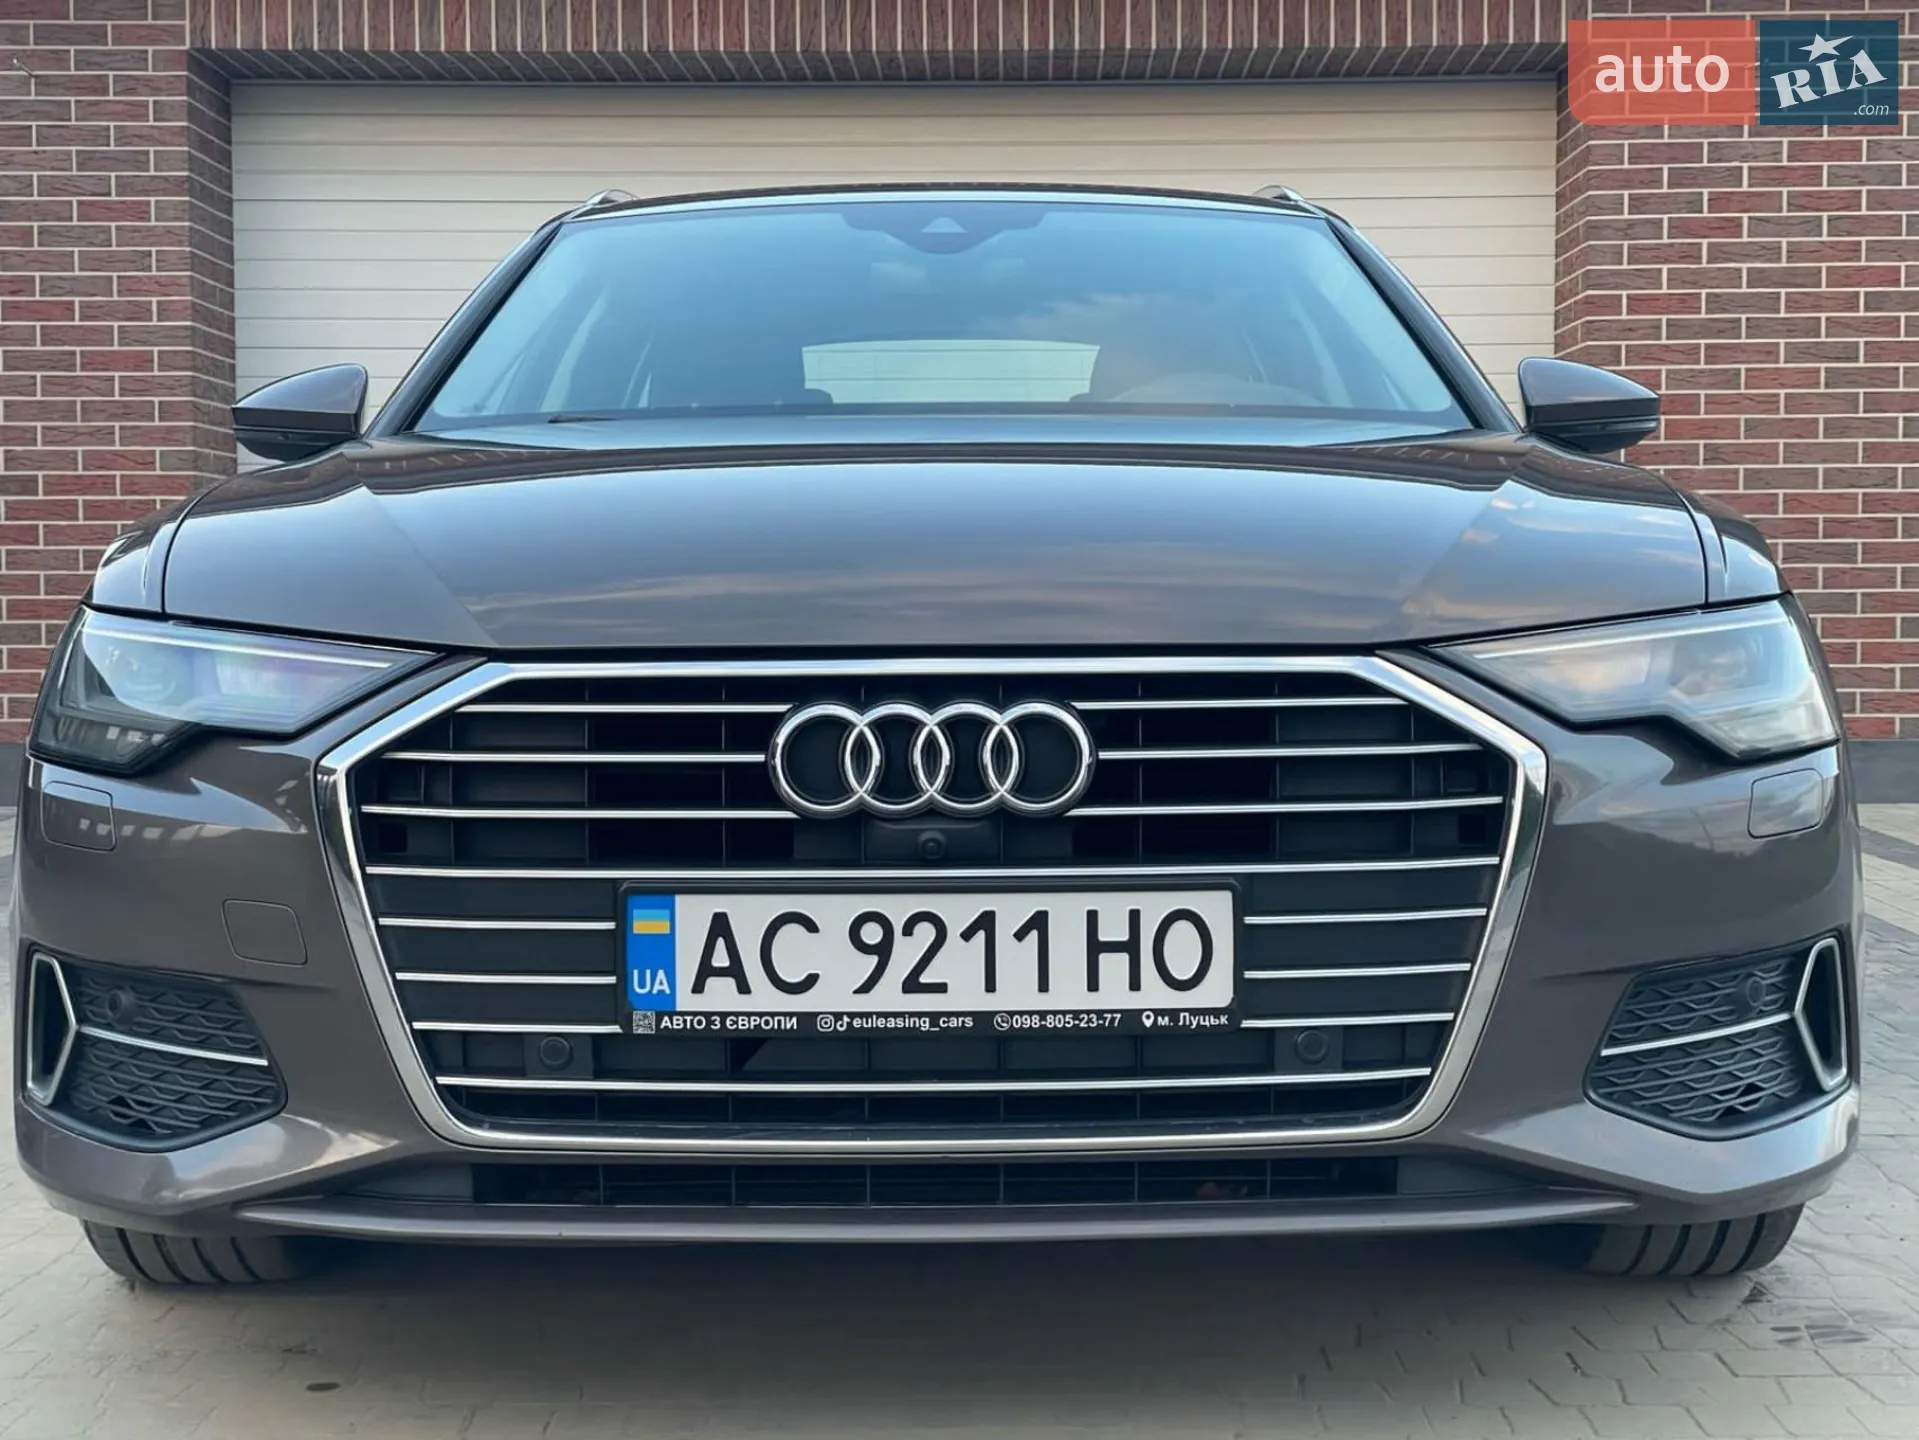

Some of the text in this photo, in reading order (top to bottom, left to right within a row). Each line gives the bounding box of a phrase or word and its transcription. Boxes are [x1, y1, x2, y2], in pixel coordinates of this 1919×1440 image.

[691, 907, 1214, 995] AC 9211 HO
[633, 969, 671, 995] UA
[660, 1015, 707, 1030] АВТО
[725, 1015, 798, 1030] ЄВРОПИ
[852, 1014, 974, 1031] euleasing_cars
[1012, 1013, 1122, 1028] 098-805-23-77
[1157, 1012, 1229, 1029] м. Луцьк
